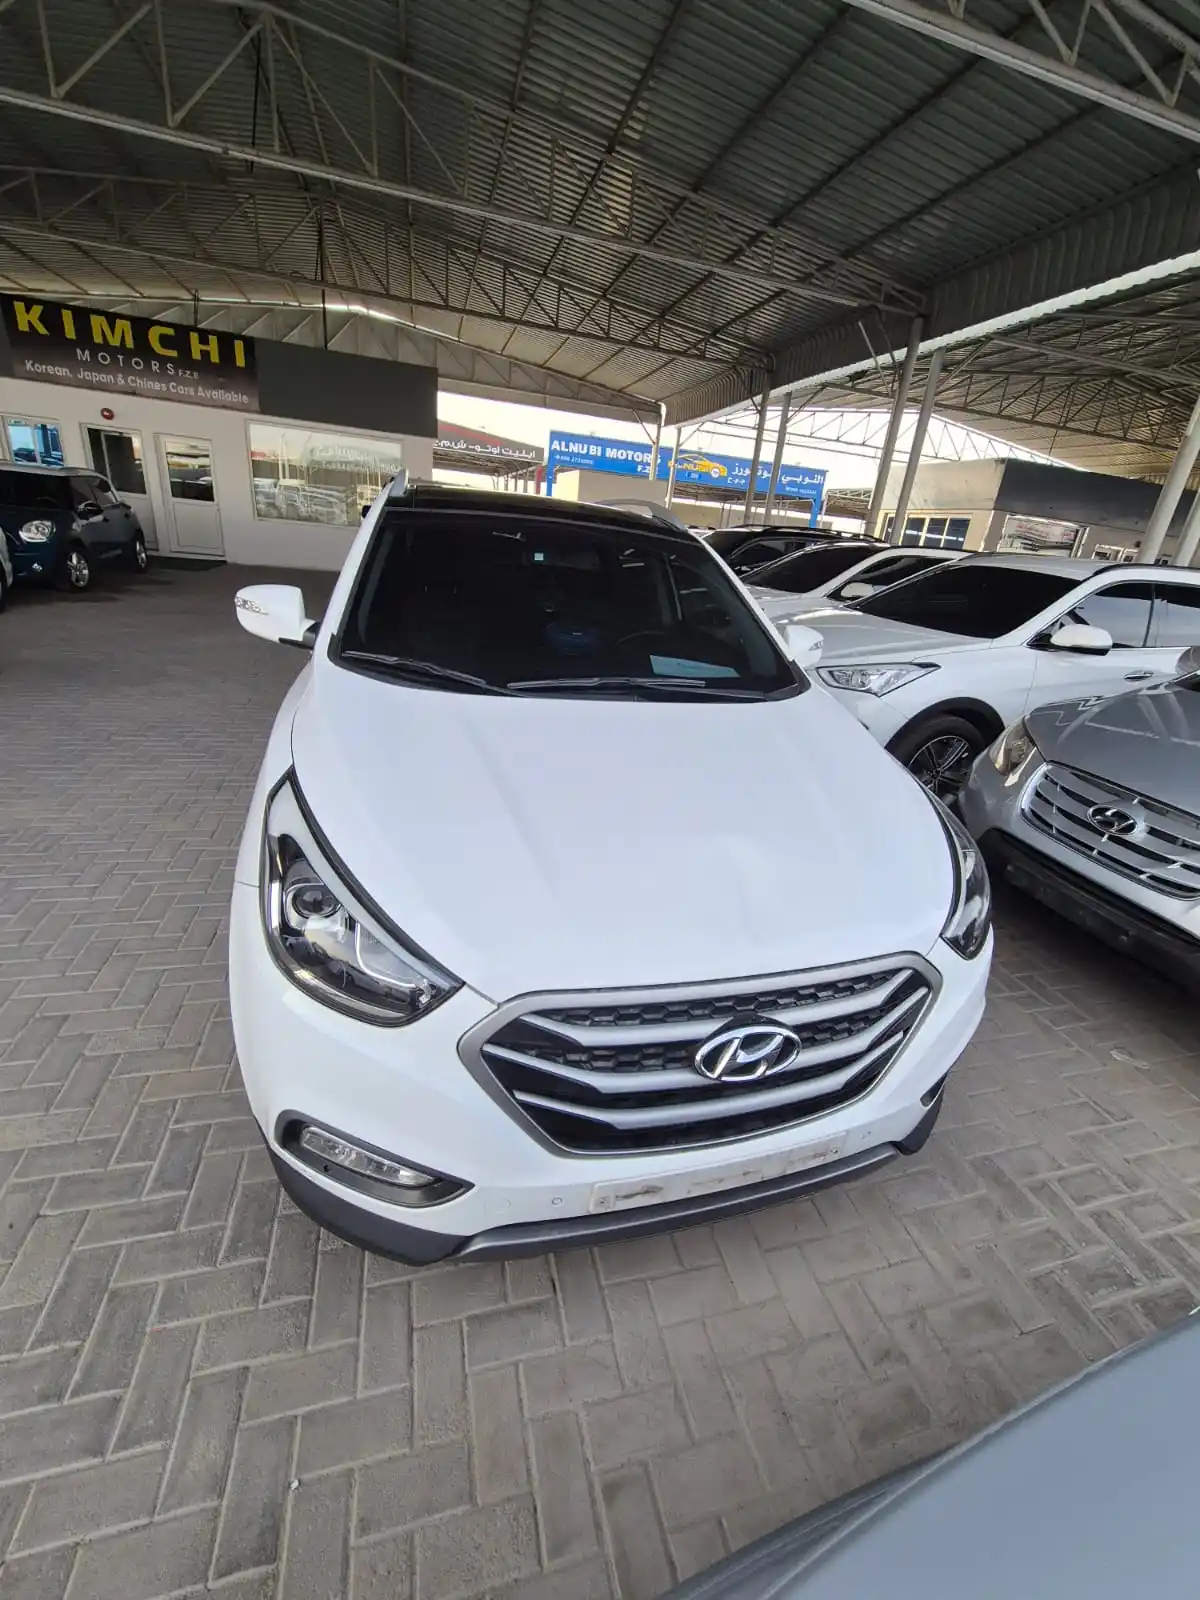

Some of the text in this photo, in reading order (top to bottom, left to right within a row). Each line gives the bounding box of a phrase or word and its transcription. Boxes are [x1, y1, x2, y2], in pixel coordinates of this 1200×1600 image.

[13, 300, 246, 368] KIMCHI
[76, 348, 175, 375] MOTORS
[77, 368, 114, 385] Japan
[117, 375, 125, 385] &
[169, 382, 195, 396] Cars
[197, 386, 249, 404] Available
[551, 440, 602, 457] ALNUBI
